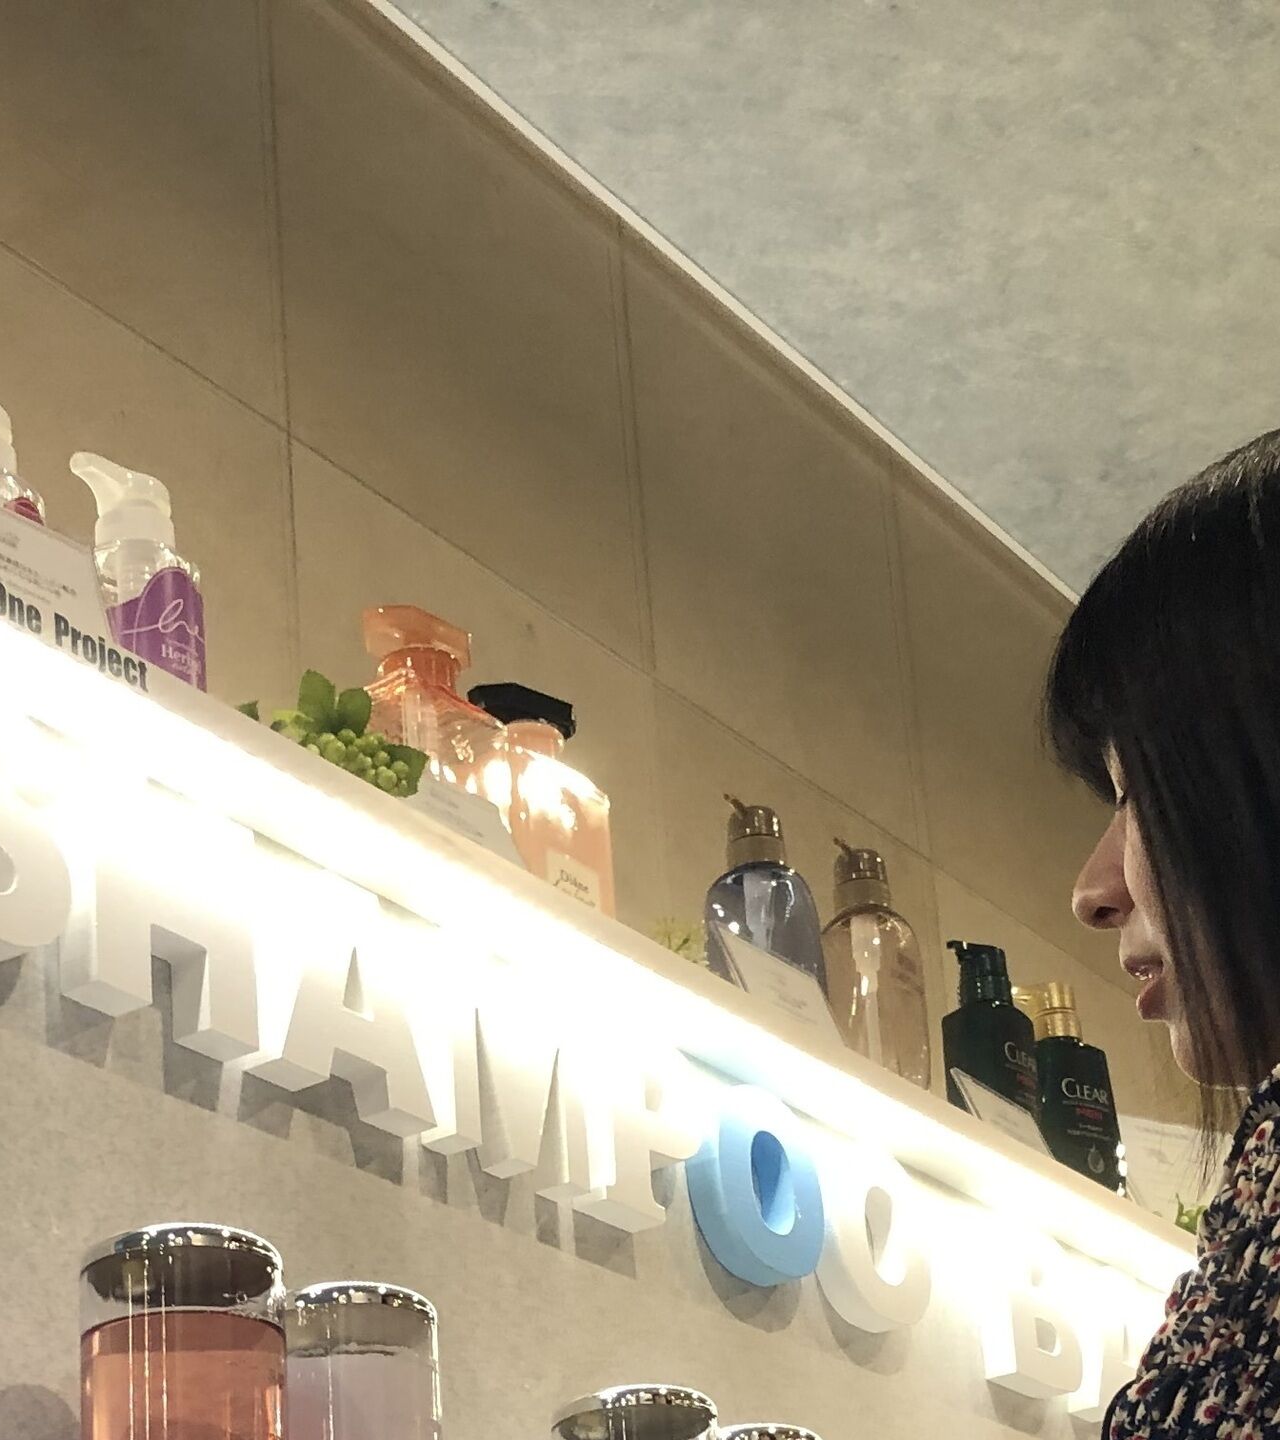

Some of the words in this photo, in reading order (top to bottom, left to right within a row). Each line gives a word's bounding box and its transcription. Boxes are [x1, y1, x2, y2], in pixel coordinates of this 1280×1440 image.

[53, 611, 149, 693] Project
[1004, 1041, 1038, 1073] CLEA
[1061, 1077, 1109, 1105] CLEAR
